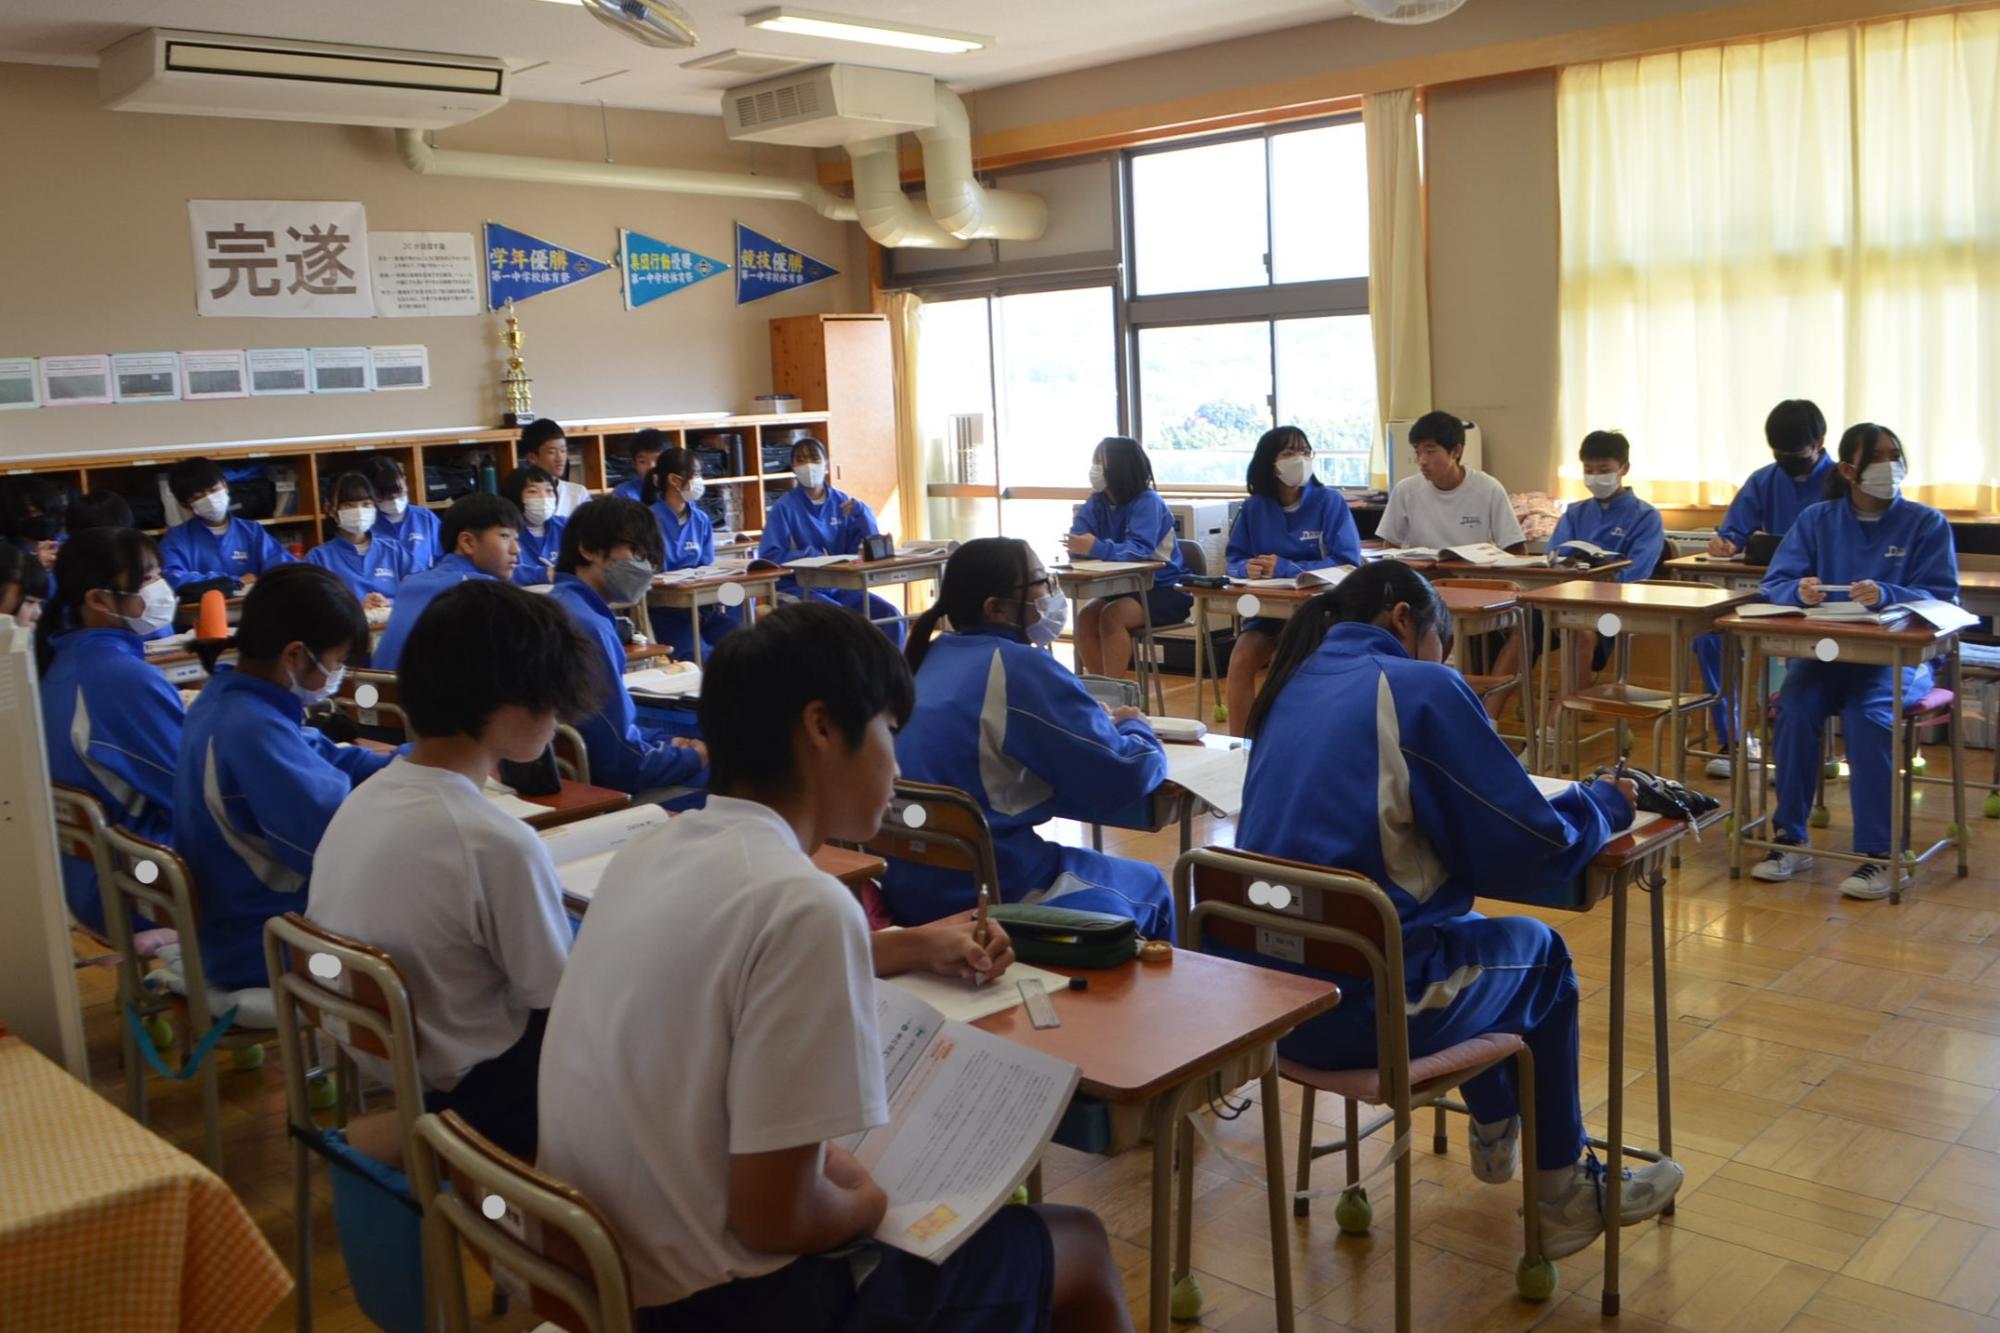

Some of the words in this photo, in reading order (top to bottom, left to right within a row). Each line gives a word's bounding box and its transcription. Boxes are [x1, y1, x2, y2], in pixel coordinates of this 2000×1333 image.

[205, 223, 357, 299] 完遂
[490, 247, 569, 272] 学年優勝
[741, 249, 804, 273] 競技優勝
[491, 270, 571, 284] 第一中学校体育祭
